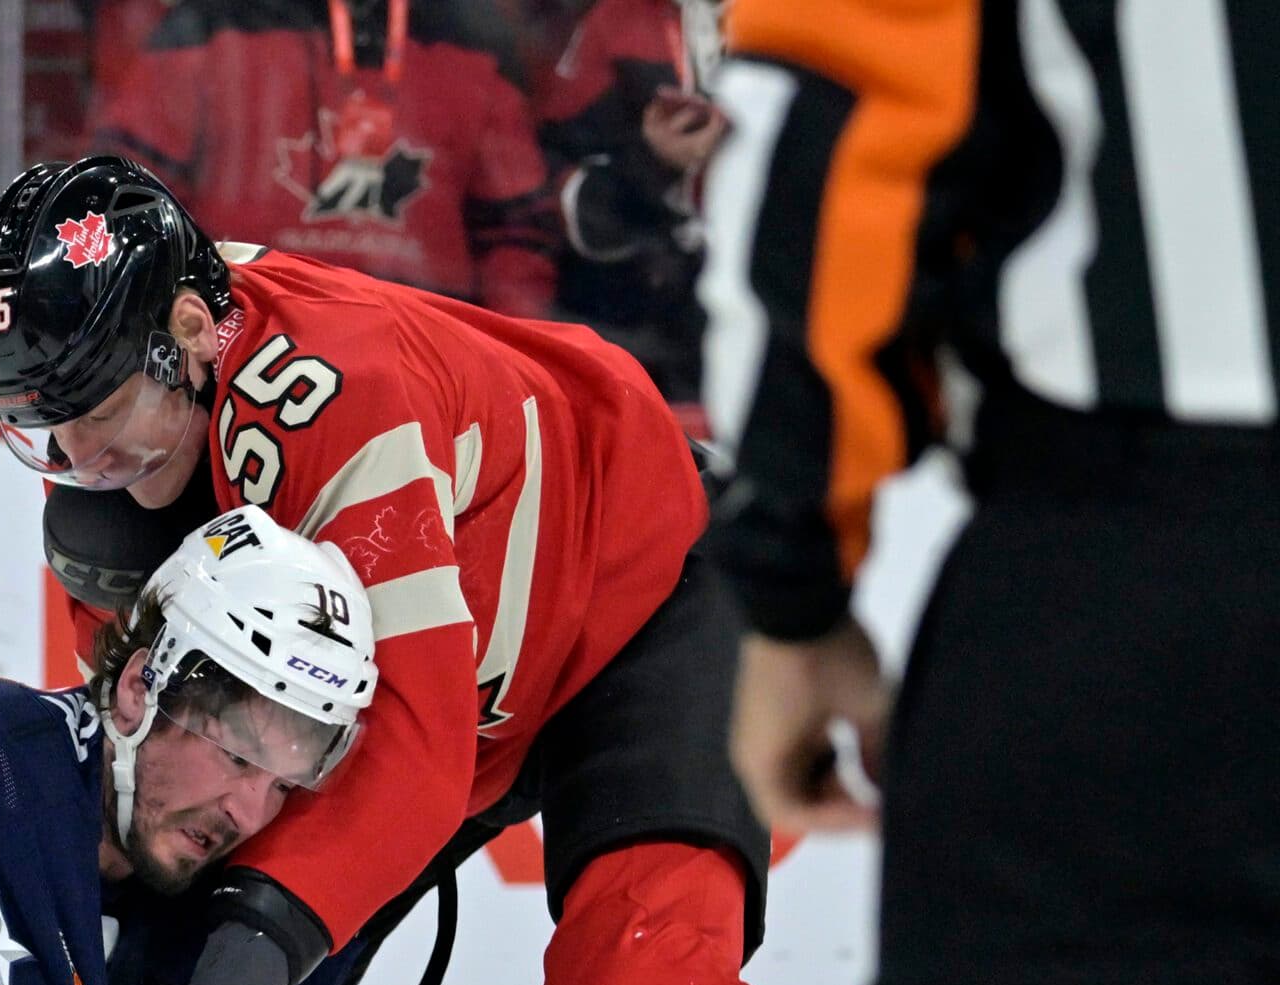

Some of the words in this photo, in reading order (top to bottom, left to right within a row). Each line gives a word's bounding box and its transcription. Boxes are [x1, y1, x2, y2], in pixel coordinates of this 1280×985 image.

[218, 333, 343, 508] 55
[314, 583, 349, 626] 10
[286, 655, 348, 688] CCM
